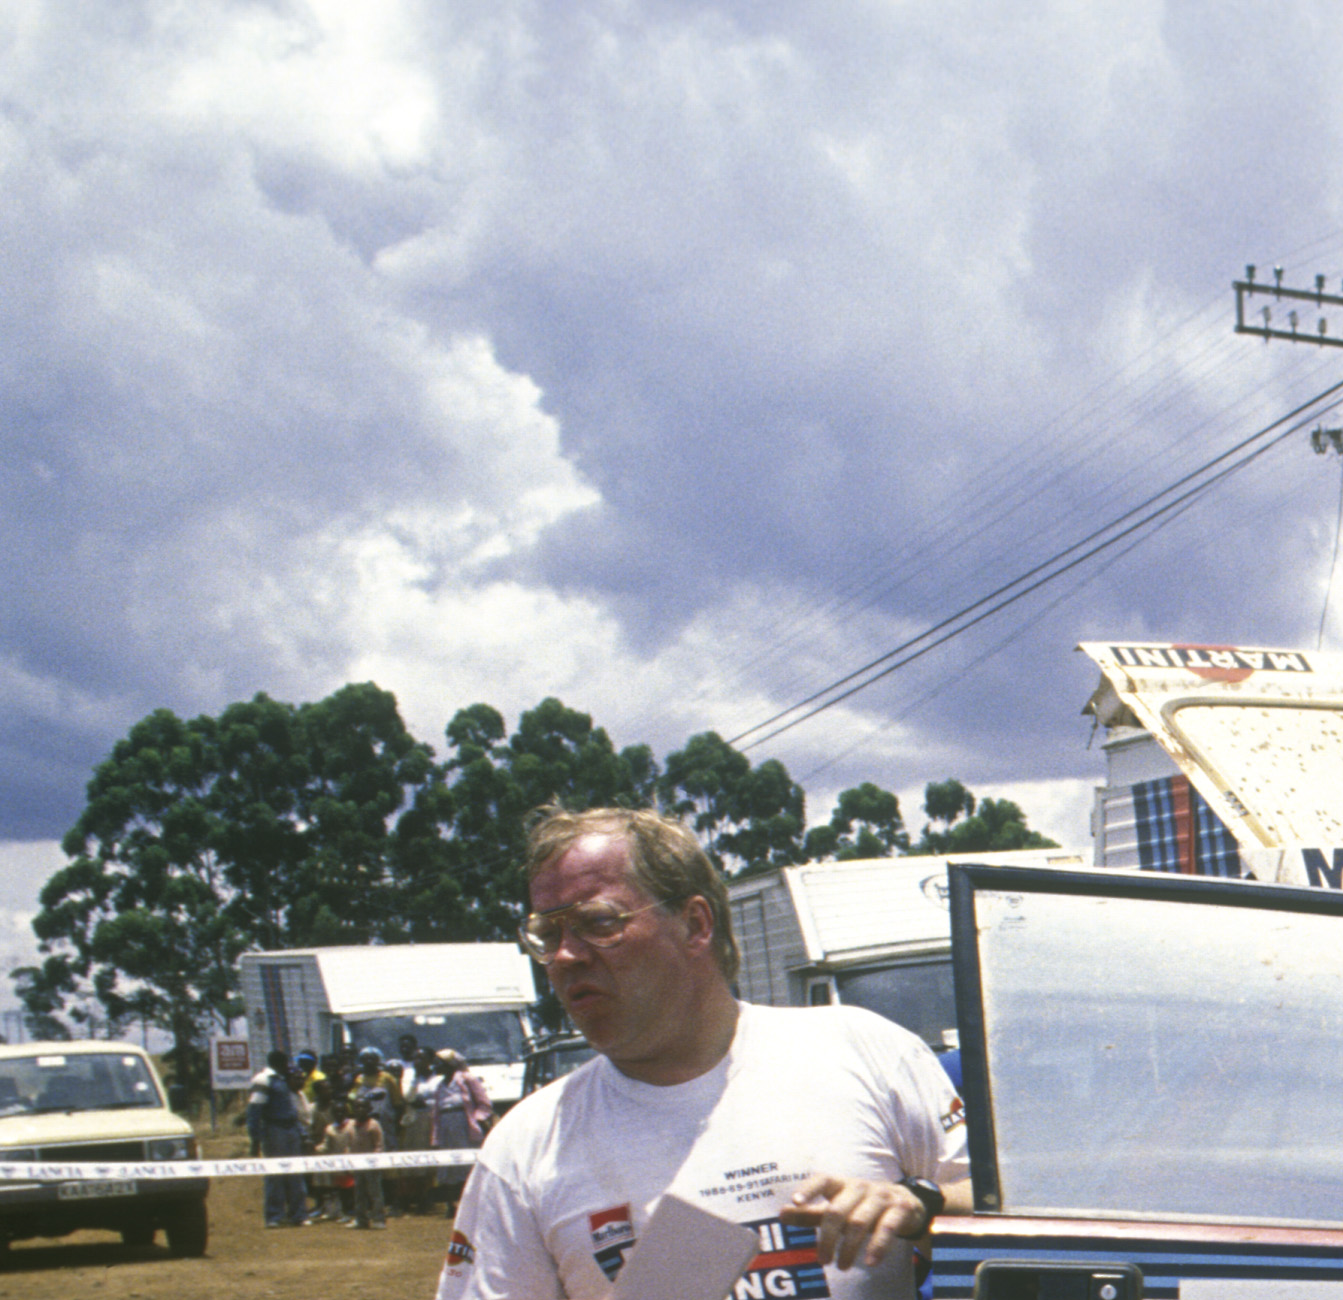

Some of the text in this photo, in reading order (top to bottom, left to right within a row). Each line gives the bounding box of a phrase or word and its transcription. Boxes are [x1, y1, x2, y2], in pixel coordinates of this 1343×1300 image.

[1117, 646, 1307, 672] MARTINI
[724, 1161, 779, 1181] WINNER
[736, 1188, 775, 1203] KENYA
